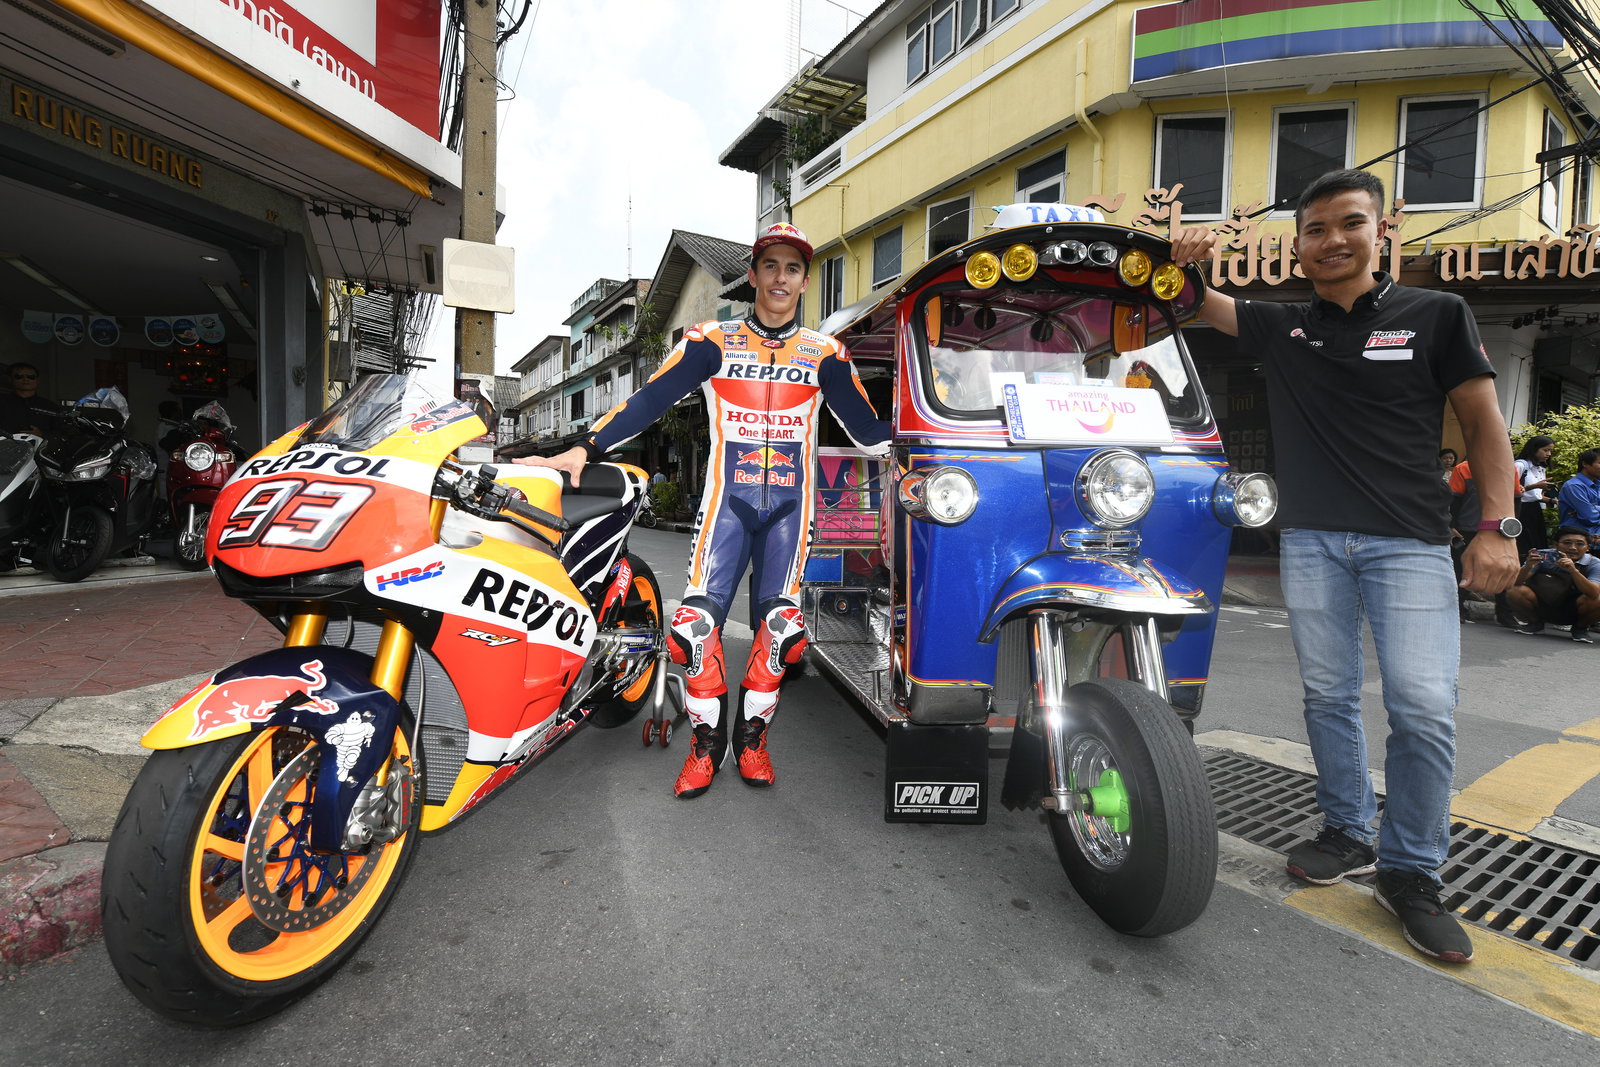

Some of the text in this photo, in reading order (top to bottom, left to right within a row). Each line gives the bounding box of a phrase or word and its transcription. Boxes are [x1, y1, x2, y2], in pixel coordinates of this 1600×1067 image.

[12, 84, 203, 188] RUNG RUANG
[1026, 206, 1095, 223] TAXI
[1440, 242, 1485, 282] ณ
[1504, 223, 1600, 280] เสาชิ
[1371, 330, 1411, 338] Honda
[799, 345, 819, 356] SHOEI
[727, 363, 812, 385] REPSOL
[1068, 390, 1109, 401] amazing
[1046, 399, 1136, 414] THAILAND
[726, 410, 804, 426] HONDA
[738, 426, 759, 437] One
[239, 451, 390, 478] REPSOL
[734, 469, 795, 486] Red Bull
[218, 478, 376, 552] 93
[376, 561, 446, 591] HRC
[462, 567, 590, 647] REPSOL
[898, 786, 976, 805] PICK UP
